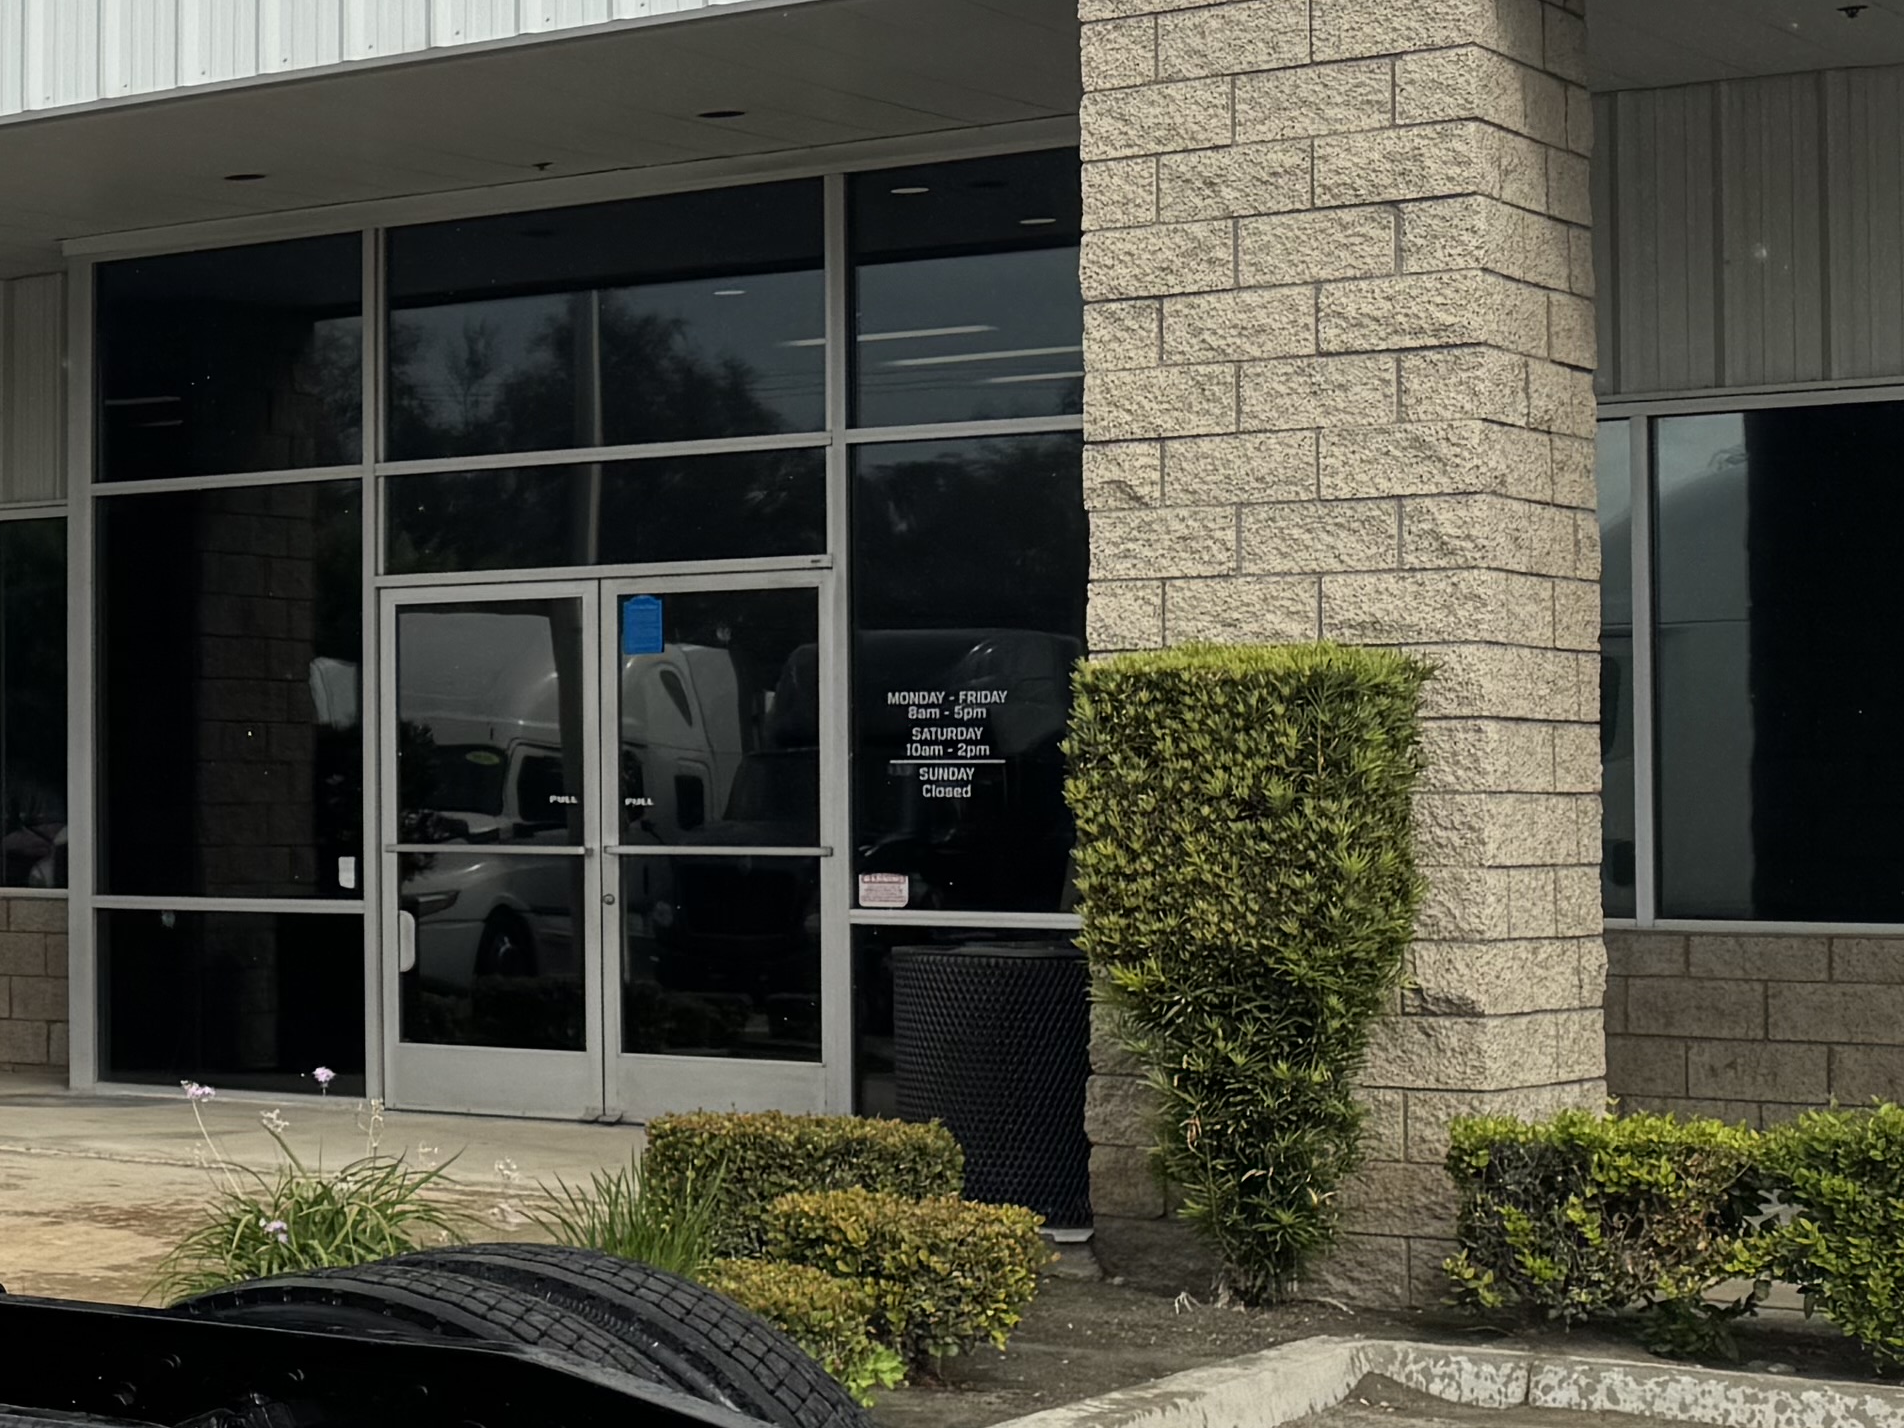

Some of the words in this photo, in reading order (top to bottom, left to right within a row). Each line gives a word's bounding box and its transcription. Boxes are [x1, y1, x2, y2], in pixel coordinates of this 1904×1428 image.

[887, 691, 945, 704] MONDAY
[958, 690, 1008, 704] FRIDAY
[907, 706, 940, 719] 8am
[953, 705, 987, 721] 5pm
[912, 727, 984, 741] SATURDAY
[906, 743, 944, 756] 10am
[957, 743, 990, 758] 2pm
[919, 767, 975, 781] SUNDAY
[922, 784, 972, 798] Closed
[549, 795, 578, 804] PULL
[624, 798, 654, 806] PULL
